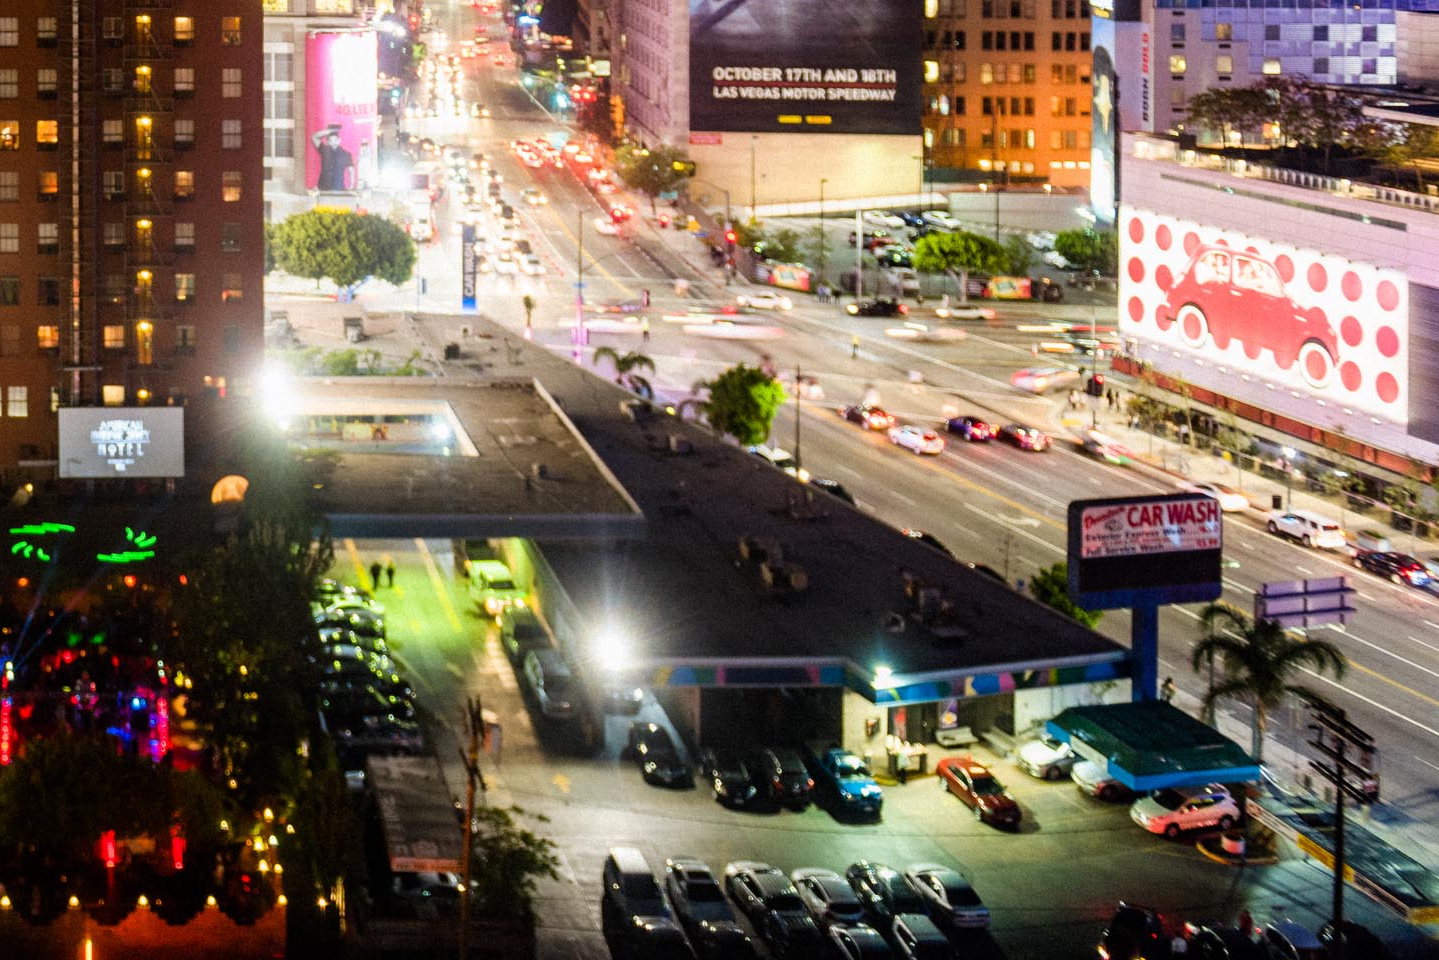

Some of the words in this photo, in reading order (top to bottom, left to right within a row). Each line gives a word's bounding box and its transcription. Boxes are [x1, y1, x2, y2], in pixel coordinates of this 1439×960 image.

[713, 67, 783, 82] OCTOBER
[785, 68, 822, 82] 17TH
[824, 69, 858, 83] AND
[860, 69, 897, 83] 18TH
[713, 87, 739, 98] LAS
[740, 87, 781, 100] VEGAS
[782, 88, 826, 100] MOTOR
[827, 88, 897, 101] SPEEDWAY
[1127, 504, 1163, 527] CAR
[1167, 501, 1218, 524] WASH
